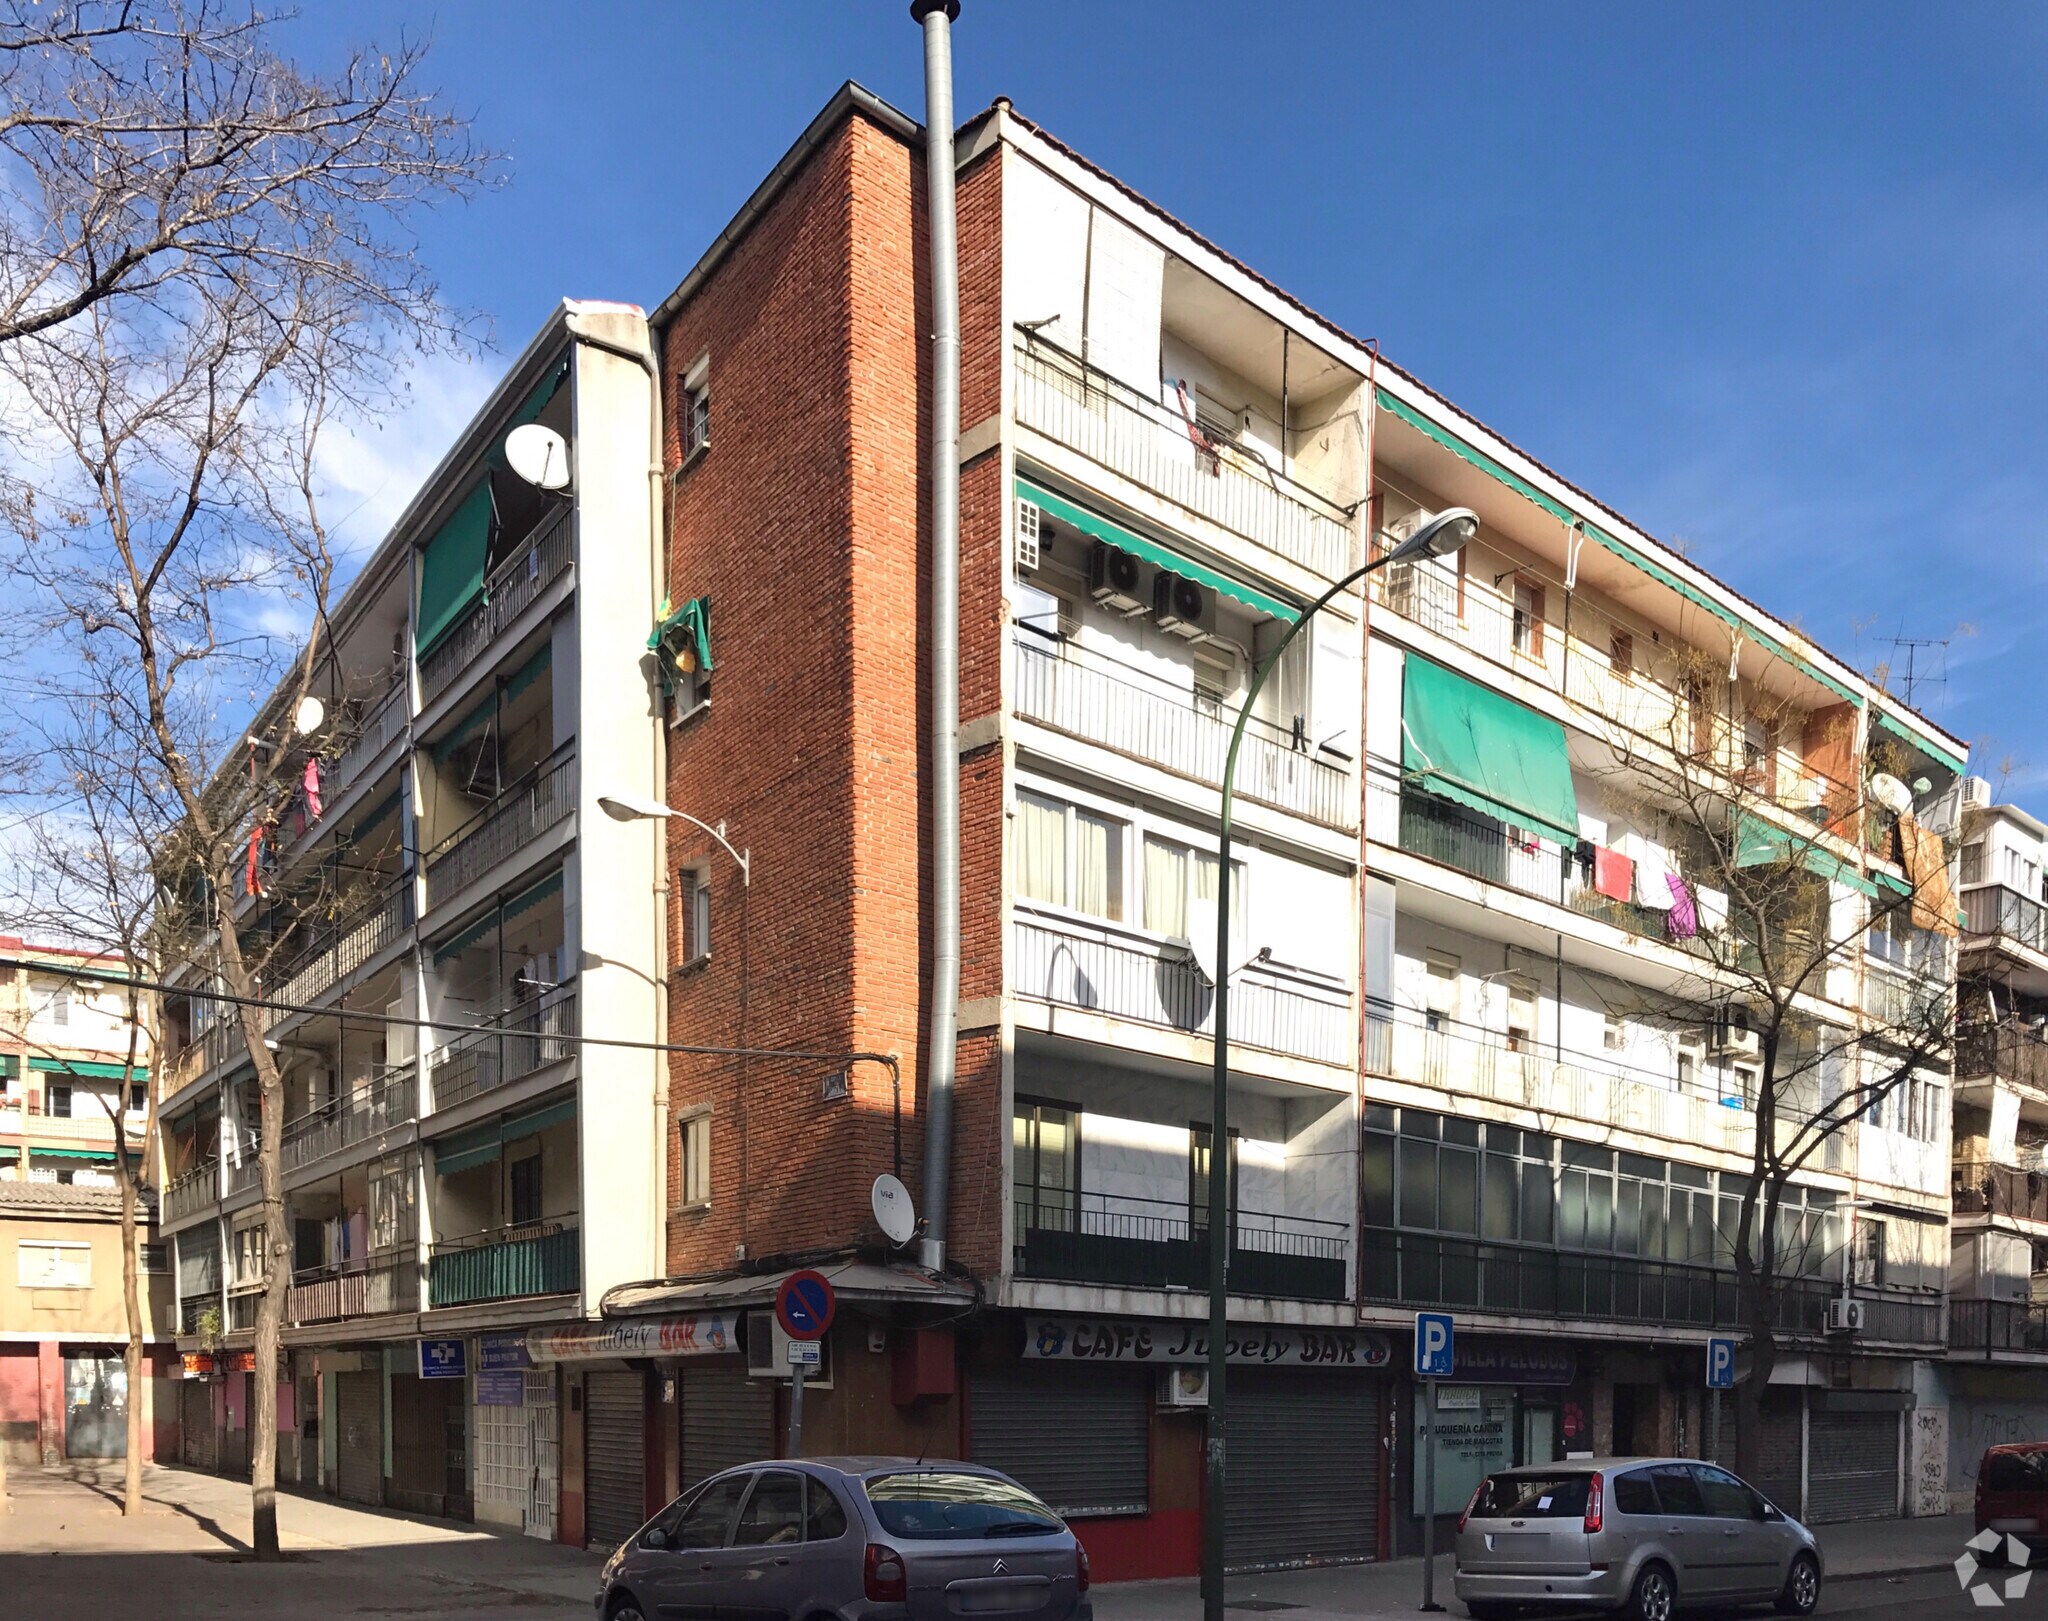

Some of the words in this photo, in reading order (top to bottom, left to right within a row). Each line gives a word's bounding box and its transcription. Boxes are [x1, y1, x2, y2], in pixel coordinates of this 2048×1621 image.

[595, 1320, 653, 1356] Jubely
[659, 1316, 699, 1350] BAR
[1300, 1332, 1356, 1363] BAR
[1425, 1320, 1447, 1367] P
[1713, 1344, 1730, 1382] P
[1420, 1423, 1471, 1435] PUQUERÍA
[1473, 1424, 1503, 1434] CANINA
[1464, 1438, 1473, 1446] DE
[1473, 1437, 1504, 1445] MASCOTAS
